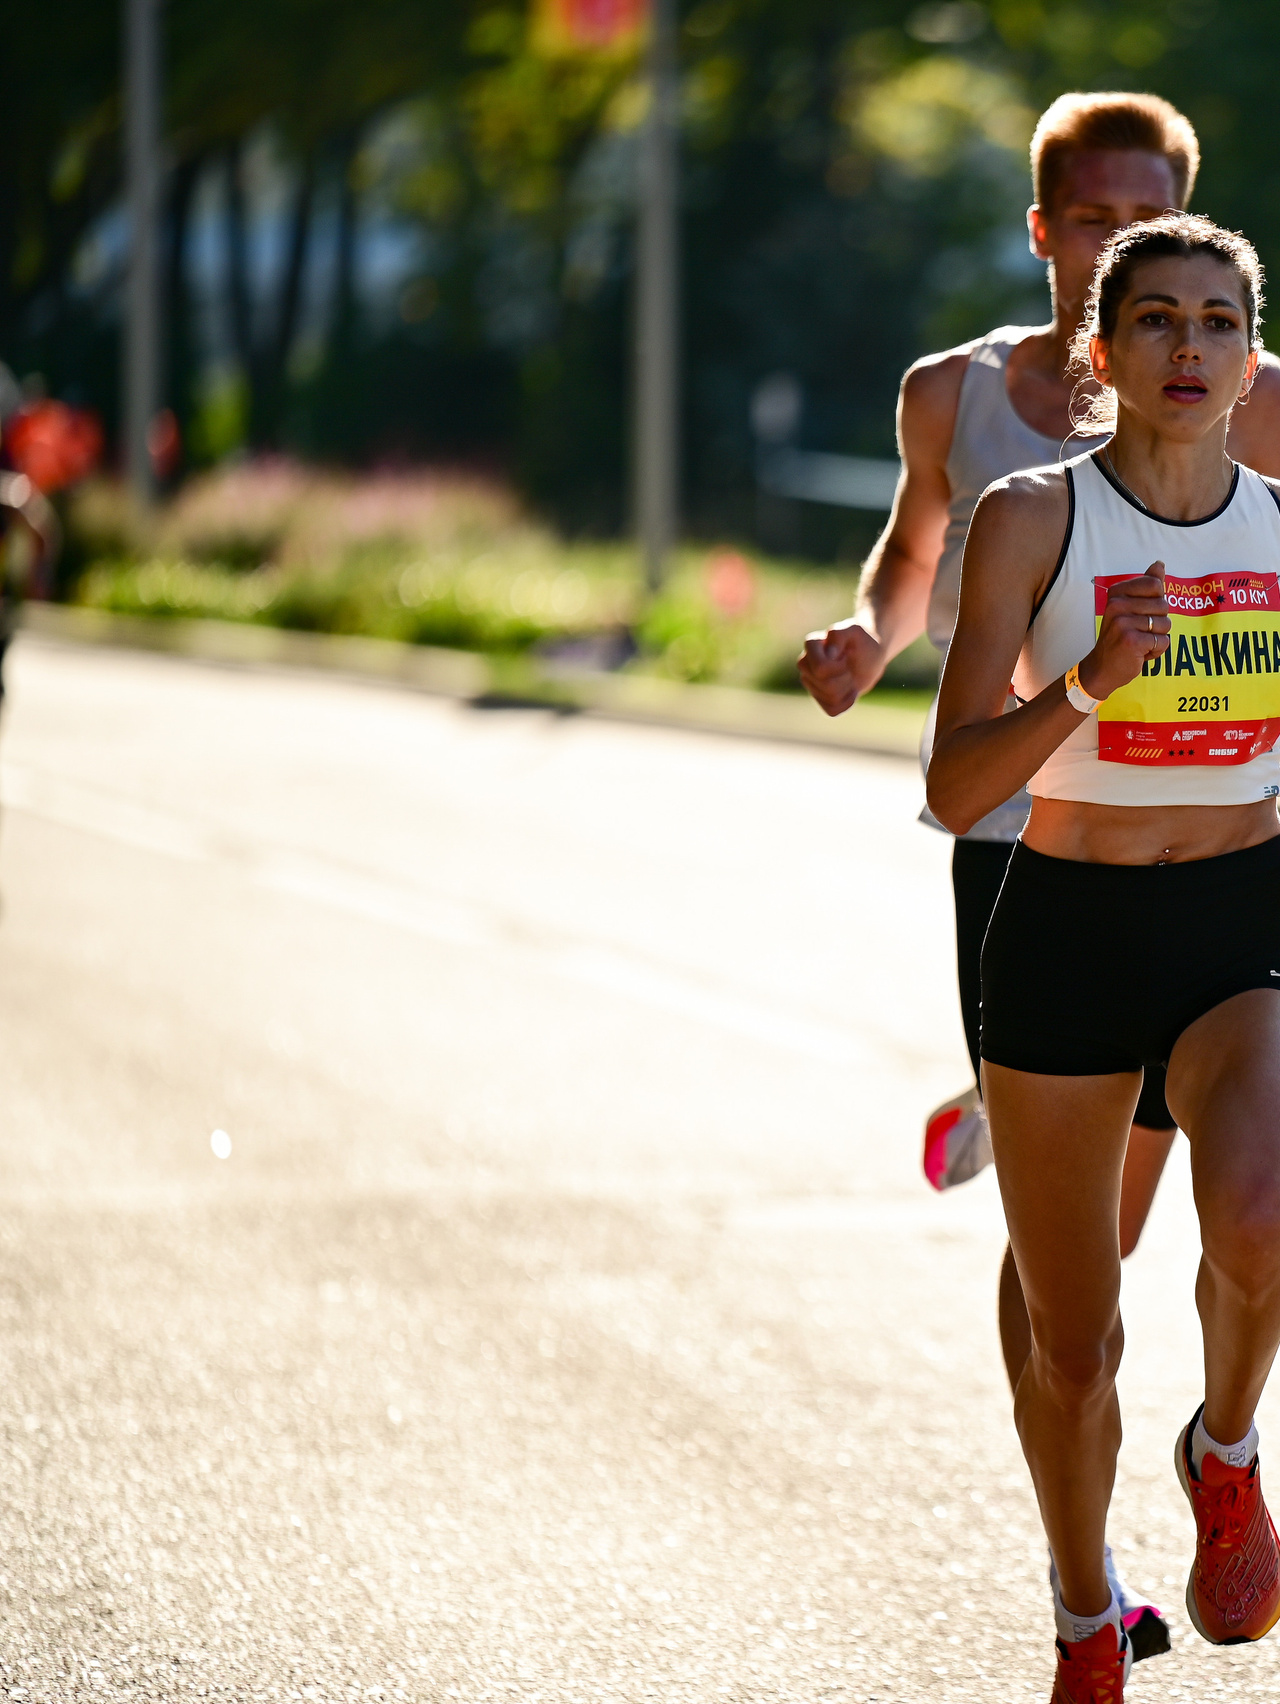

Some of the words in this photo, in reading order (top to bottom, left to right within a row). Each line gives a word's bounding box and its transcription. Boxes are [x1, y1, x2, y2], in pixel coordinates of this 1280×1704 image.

[1163, 592, 1215, 610] ОСКВА
[1229, 589, 1247, 605] 10
[1249, 589, 1269, 605] КМ
[1177, 695, 1229, 712] 22031
